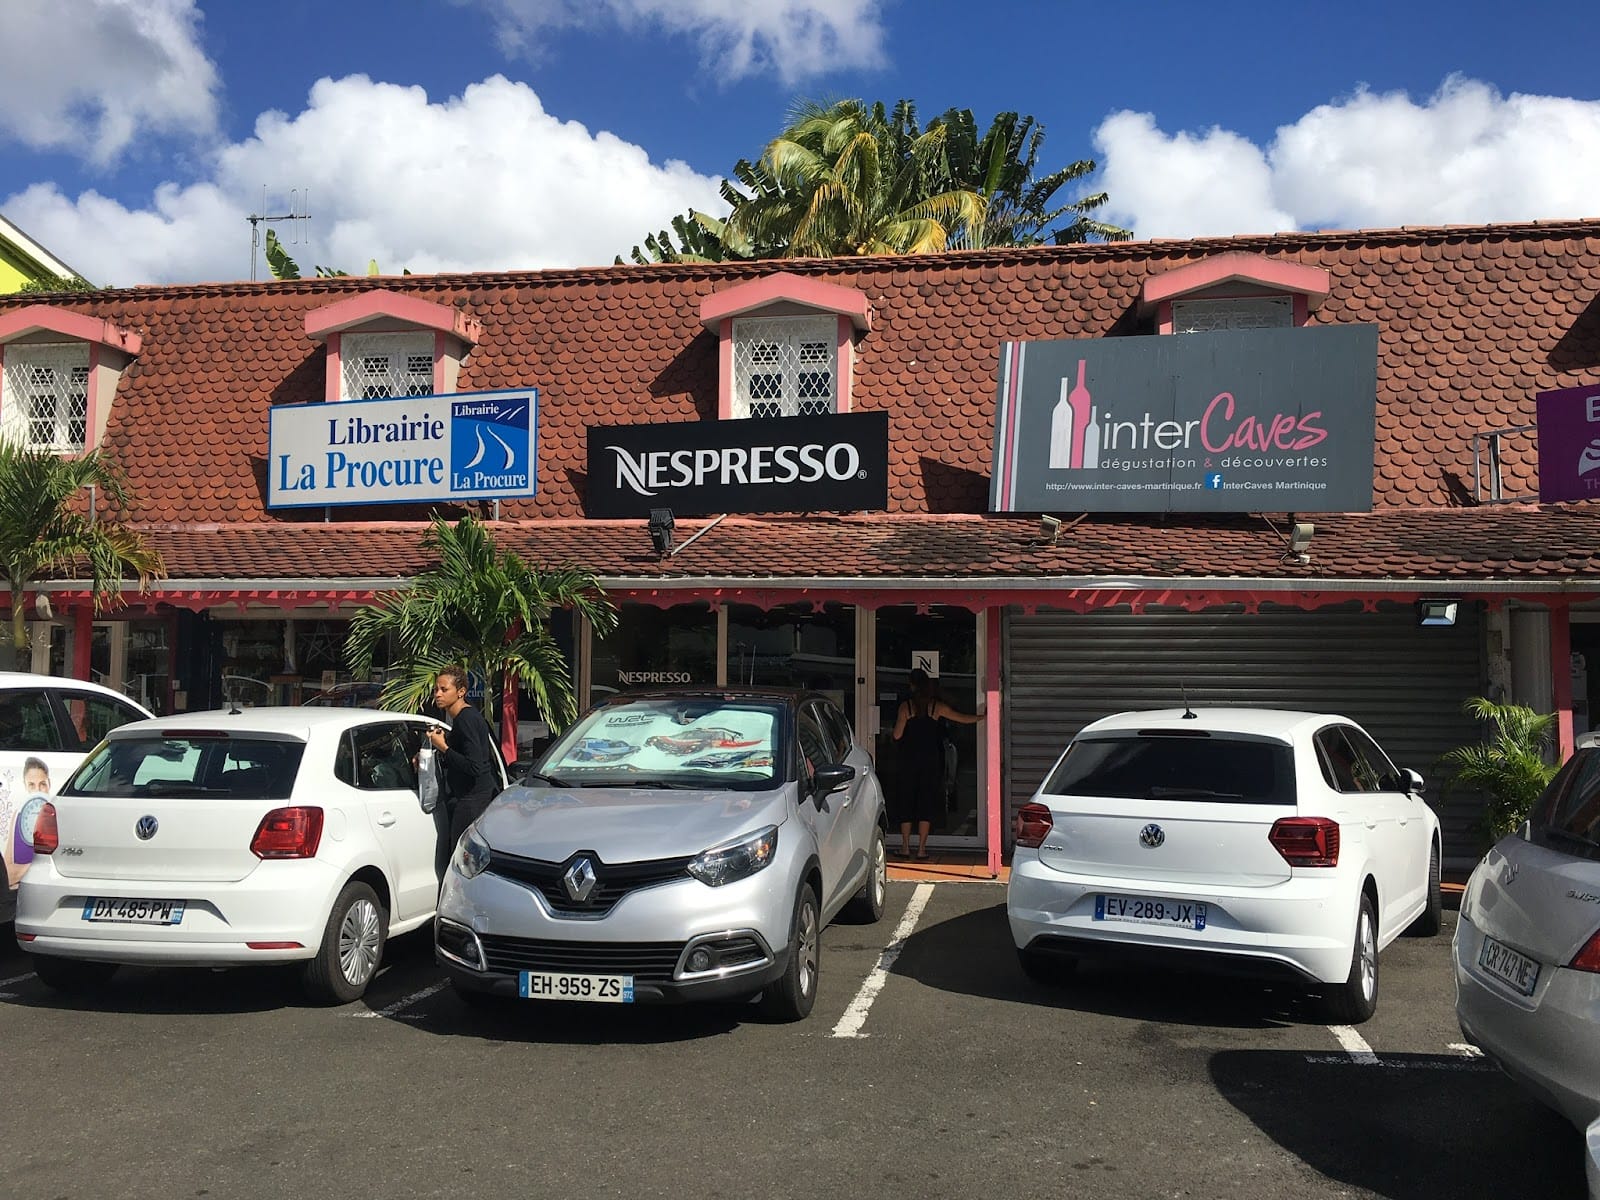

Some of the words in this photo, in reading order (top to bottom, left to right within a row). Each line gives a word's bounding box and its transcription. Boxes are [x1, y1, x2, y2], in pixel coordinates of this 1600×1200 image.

[454, 404, 500, 417] Librairie
[328, 413, 445, 446] Librairie
[278, 454, 317, 491] La
[325, 451, 444, 489] Procure
[1101, 457, 1197, 472] dégustation
[1203, 457, 1213, 469] &
[1221, 455, 1328, 468] découvertes
[453, 474, 471, 489] La
[474, 471, 527, 487] Procure
[1223, 481, 1273, 490] InterCaves
[1275, 481, 1327, 491] Martinique
[616, 668, 691, 686] NESPRESSO
